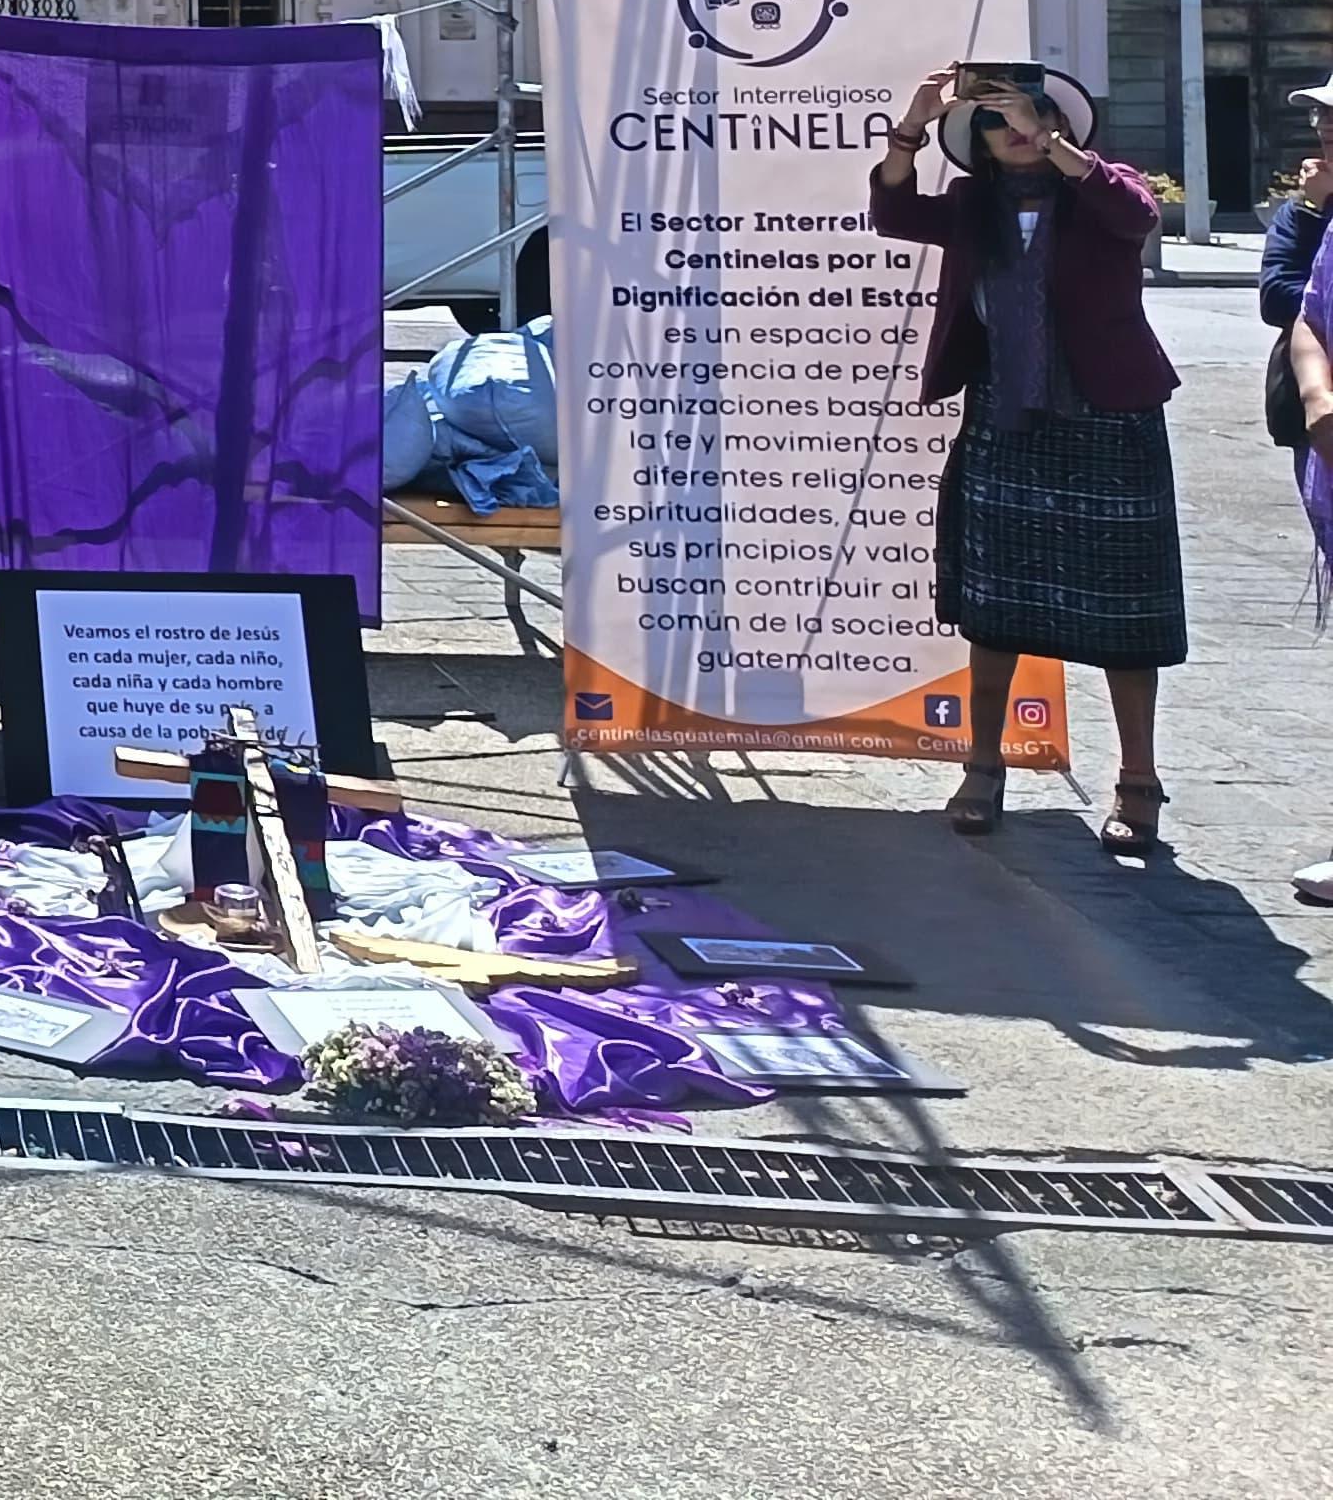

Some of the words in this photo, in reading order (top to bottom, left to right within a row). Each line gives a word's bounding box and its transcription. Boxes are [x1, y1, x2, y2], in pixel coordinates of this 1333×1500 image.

[643, 87, 720, 106] Sector
[733, 86, 892, 109] Interreligioso
[621, 212, 642, 233] El
[650, 213, 744, 233] Sector
[753, 213, 875, 233] Interreli
[664, 250, 820, 270] Centinelas
[828, 252, 879, 275] por
[886, 251, 911, 270] la
[612, 285, 800, 311] Dignificación
[808, 287, 852, 308] del
[664, 327, 697, 345] es
[706, 327, 741, 345] un
[750, 325, 872, 350] espacio
[881, 324, 919, 345] de
[588, 358, 796, 383] convergencia
[805, 359, 843, 380] de
[587, 395, 819, 419] organizaciones
[828, 396, 961, 418] basadas
[630, 429, 656, 450] la
[664, 430, 692, 451] fe
[701, 435, 715, 455] y
[725, 430, 918, 453] movimientos
[633, 465, 783, 489] diferentes
[792, 468, 942, 494] religiones
[594, 501, 839, 528] espiritualidades,
[849, 504, 908, 529] que
[628, 539, 677, 558] sus
[685, 535, 832, 564] principios
[841, 543, 856, 565] y
[617, 573, 726, 595] buscan
[735, 573, 881, 599] contribuir
[891, 578, 918, 601] al
[64, 624, 131, 639] Veamos
[136, 625, 150, 639] el
[155, 627, 205, 640] rostro
[210, 626, 231, 641] de
[236, 626, 280, 642] Jesús
[639, 607, 740, 633] común
[749, 610, 787, 634] de
[797, 610, 822, 634] la
[832, 614, 958, 638] socieda
[68, 652, 89, 663] en
[94, 649, 132, 663] cada
[138, 651, 191, 668] mujer,
[196, 651, 234, 665] cada
[240, 651, 283, 668] niño,
[698, 646, 918, 674] guatemalteca.
[72, 674, 111, 689] cada
[117, 674, 153, 689] niña
[159, 677, 167, 692] y
[172, 675, 211, 690] cada
[216, 675, 283, 692] hombre
[87, 700, 118, 715] que
[123, 699, 164, 716] huye
[170, 699, 190, 714] de
[196, 702, 214, 715] su
[264, 704, 274, 716] a
[79, 725, 126, 739] causa
[132, 724, 152, 739] de
[157, 724, 173, 739] la
[576, 726, 894, 751] centinelasguatemala@gmail.com
